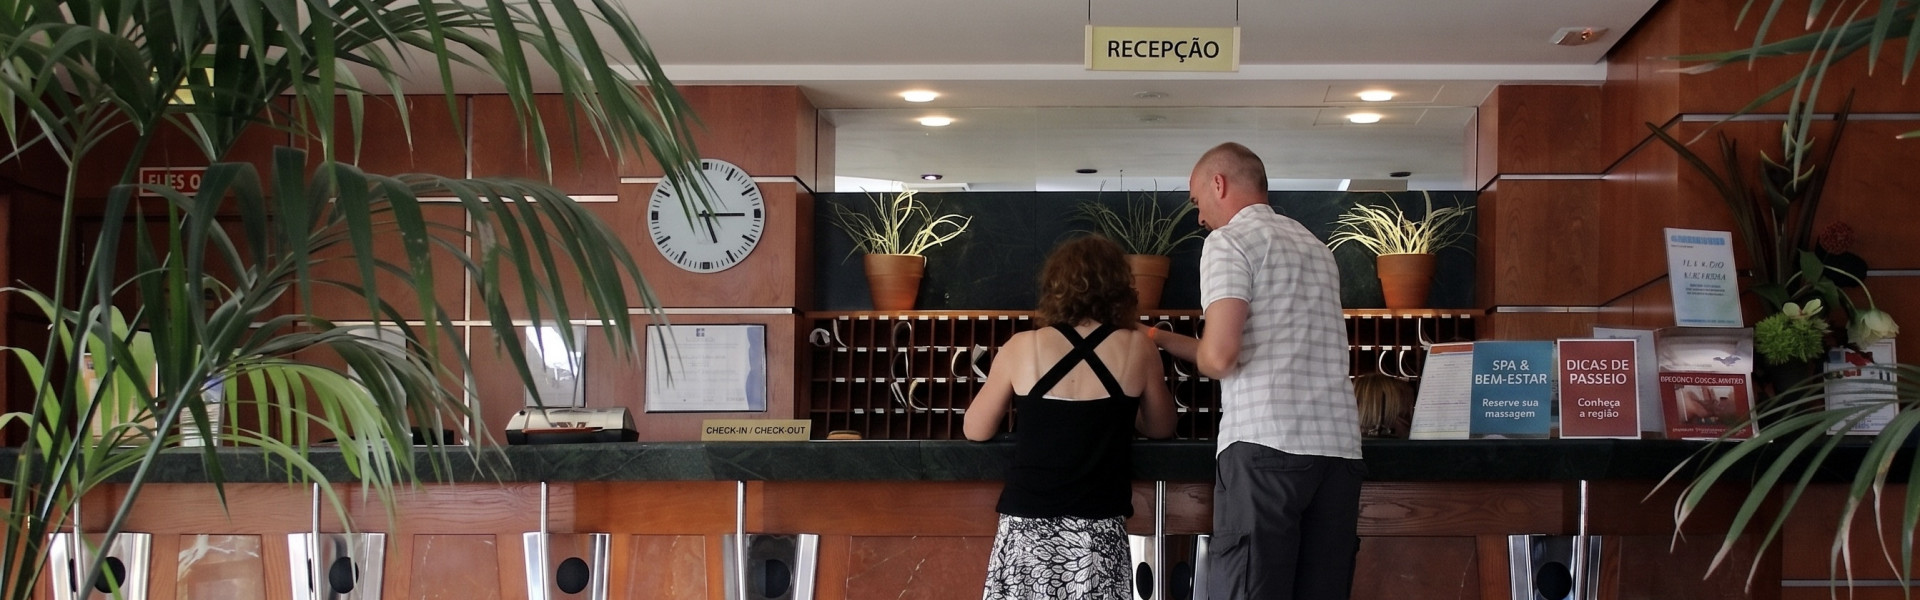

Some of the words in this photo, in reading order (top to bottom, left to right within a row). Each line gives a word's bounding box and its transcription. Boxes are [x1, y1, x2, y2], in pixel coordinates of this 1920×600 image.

[1107, 37, 1219, 62] RECEPÇÃO
[1492, 359, 1516, 371] SPA
[1520, 359, 1530, 371] &
[1566, 359, 1608, 371] DICAS
[1611, 359, 1630, 371] DE
[1475, 373, 1547, 385] BEM-ESTAR
[1569, 373, 1627, 385] PASSEIO
[1482, 398, 1520, 407] Reserve
[1577, 398, 1621, 409] Conheça
[1485, 411, 1536, 420] massagem
[1587, 409, 1619, 420] região
[706, 426, 747, 435] CHECK-IN
[754, 426, 806, 435] CHECK-OUT
